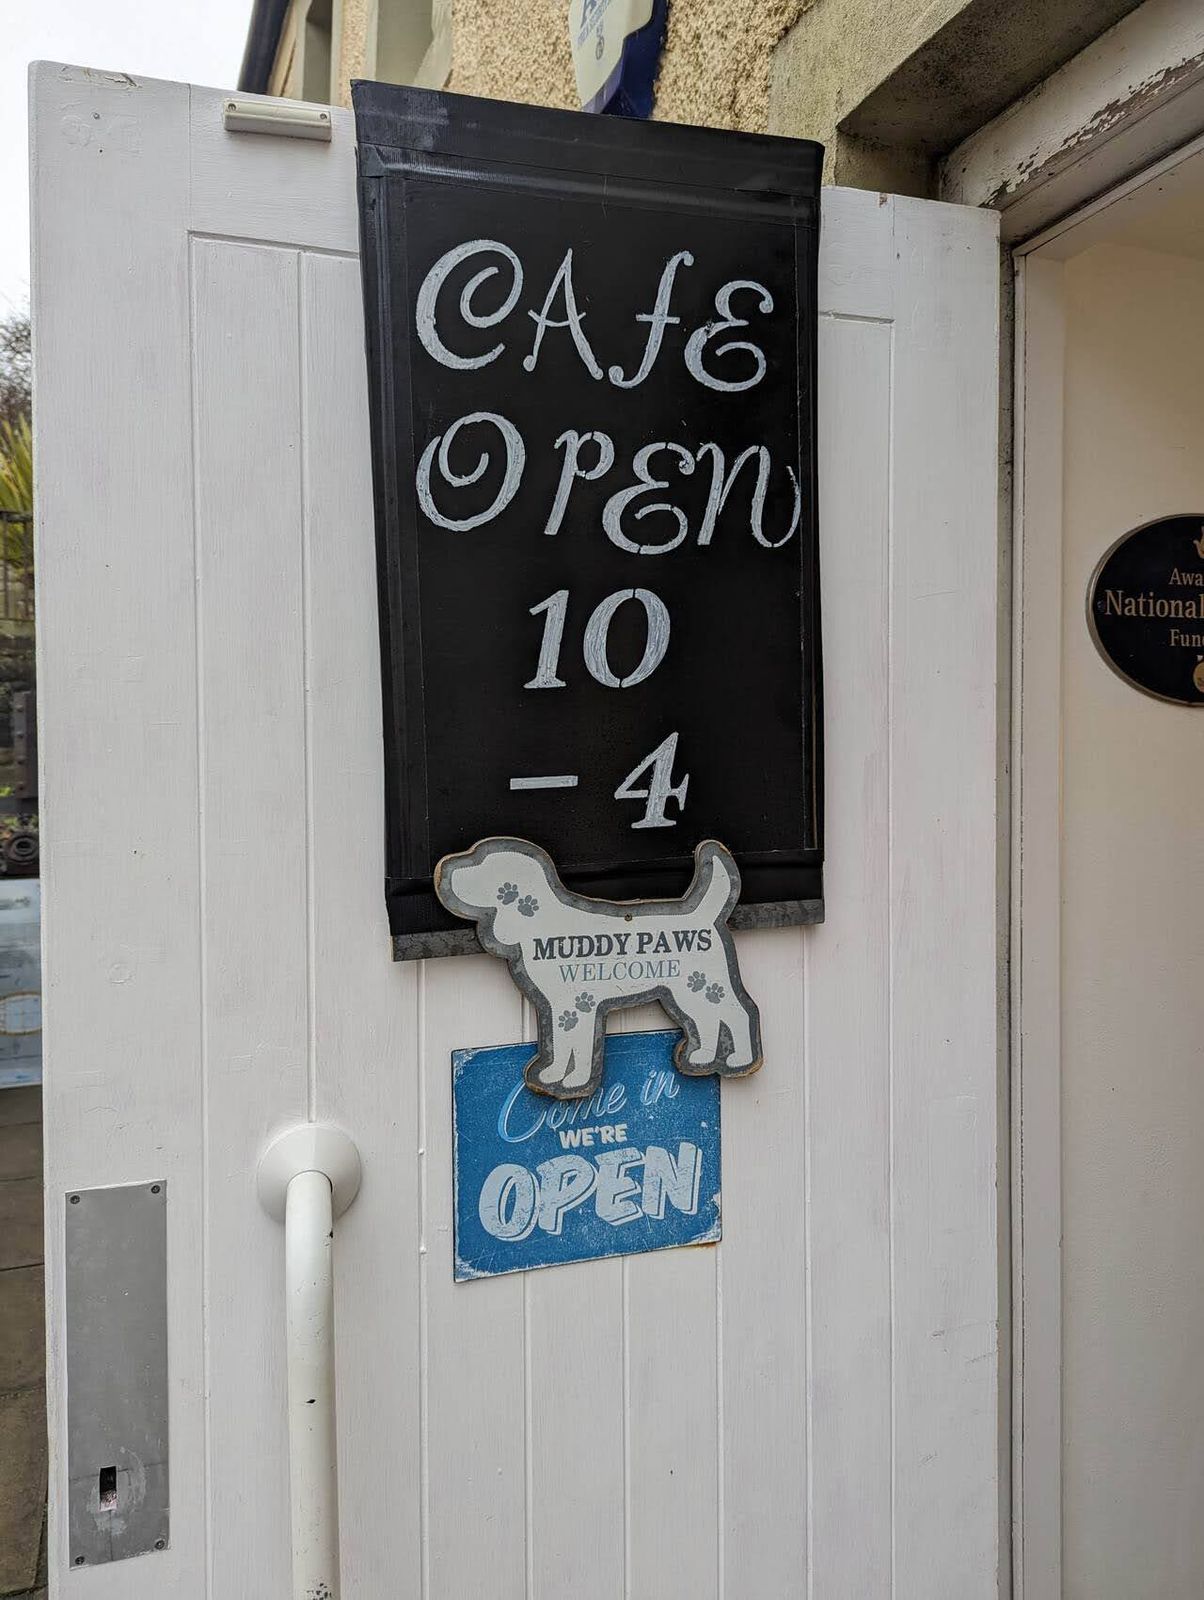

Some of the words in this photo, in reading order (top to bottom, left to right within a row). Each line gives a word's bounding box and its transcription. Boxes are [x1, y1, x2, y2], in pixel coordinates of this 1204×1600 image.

[1104, 589, 1204, 619] National
[523, 588, 671, 689] 10
[1169, 628, 1204, 648] Fun
[614, 731, 690, 829] 4
[532, 932, 631, 961] MUDDY
[636, 928, 712, 955] PAWS
[559, 959, 681, 983] WELCOME
[640, 1069, 681, 1106] in
[559, 1123, 628, 1149] WE'RE
[478, 1141, 703, 1242] OPEN
